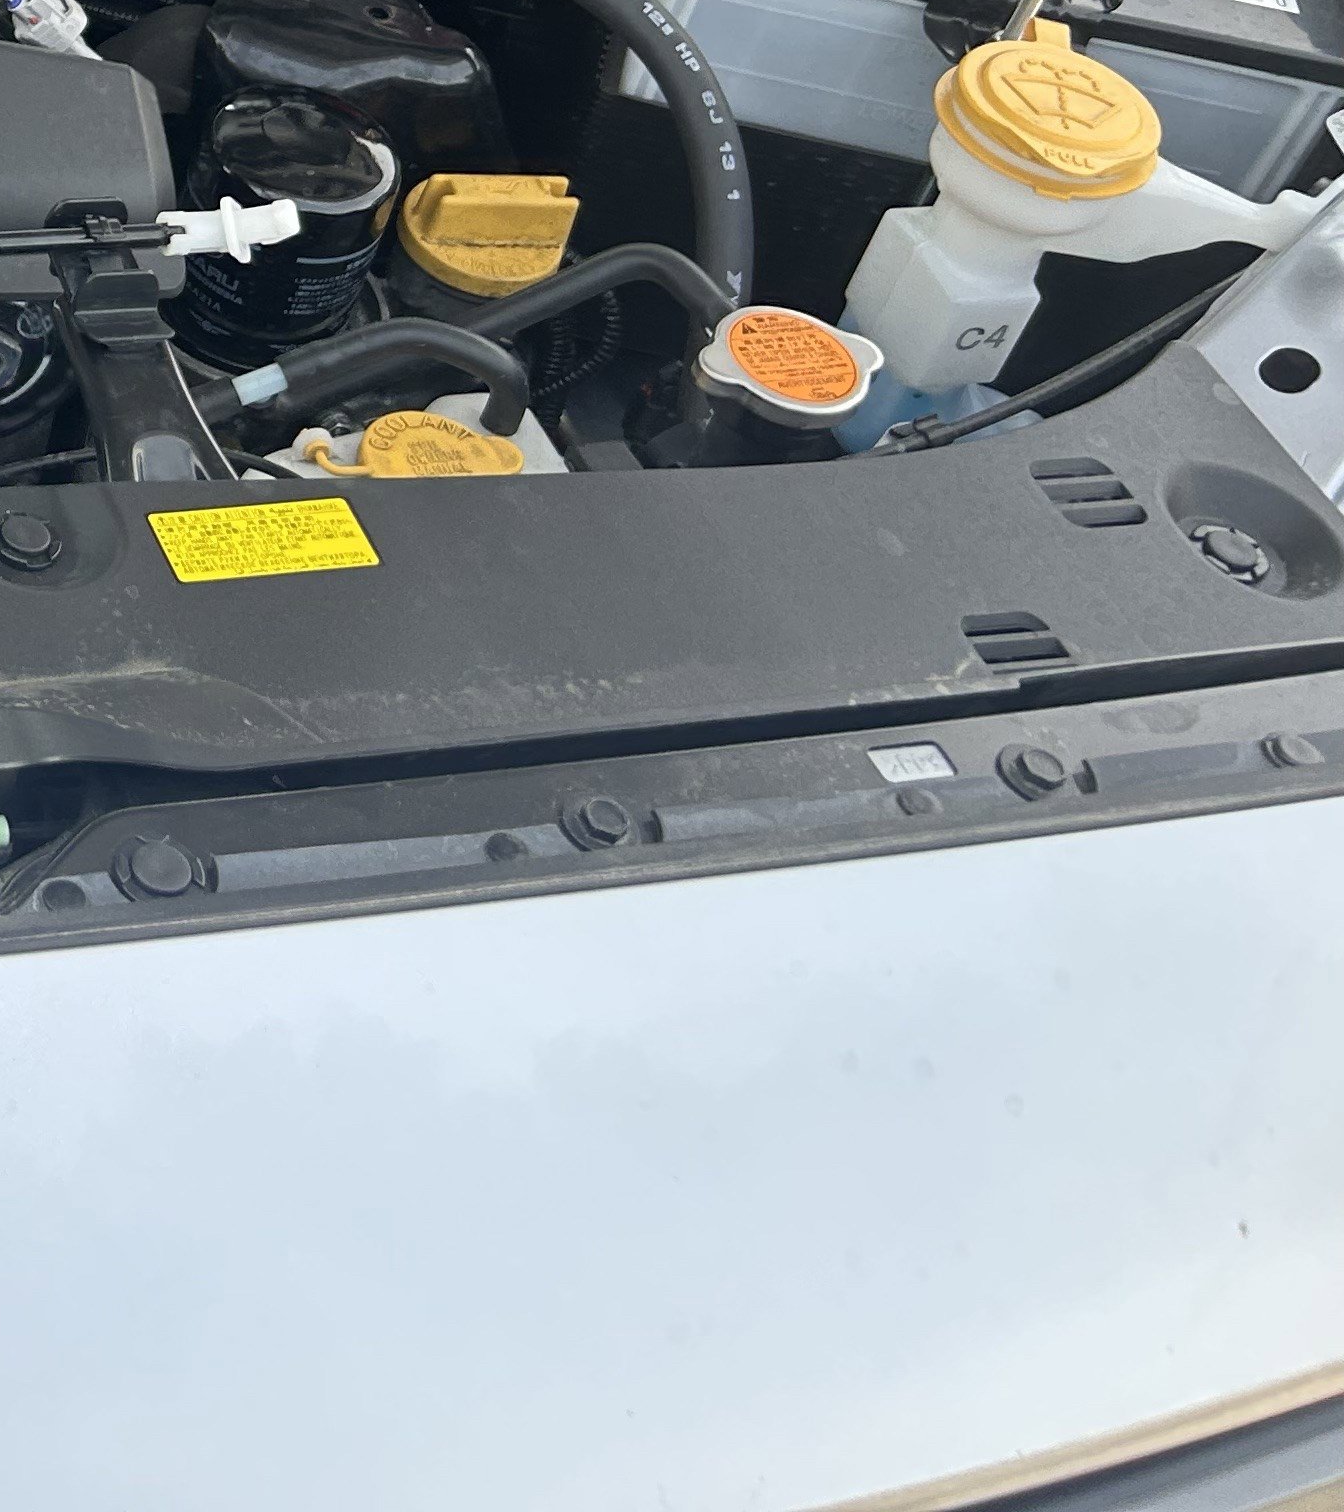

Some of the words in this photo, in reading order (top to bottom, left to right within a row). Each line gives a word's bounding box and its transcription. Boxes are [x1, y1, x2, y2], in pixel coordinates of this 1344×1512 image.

[675, 41, 701, 72] HP
[955, 325, 1009, 350] C4
[369, 414, 476, 451] COOLANT
